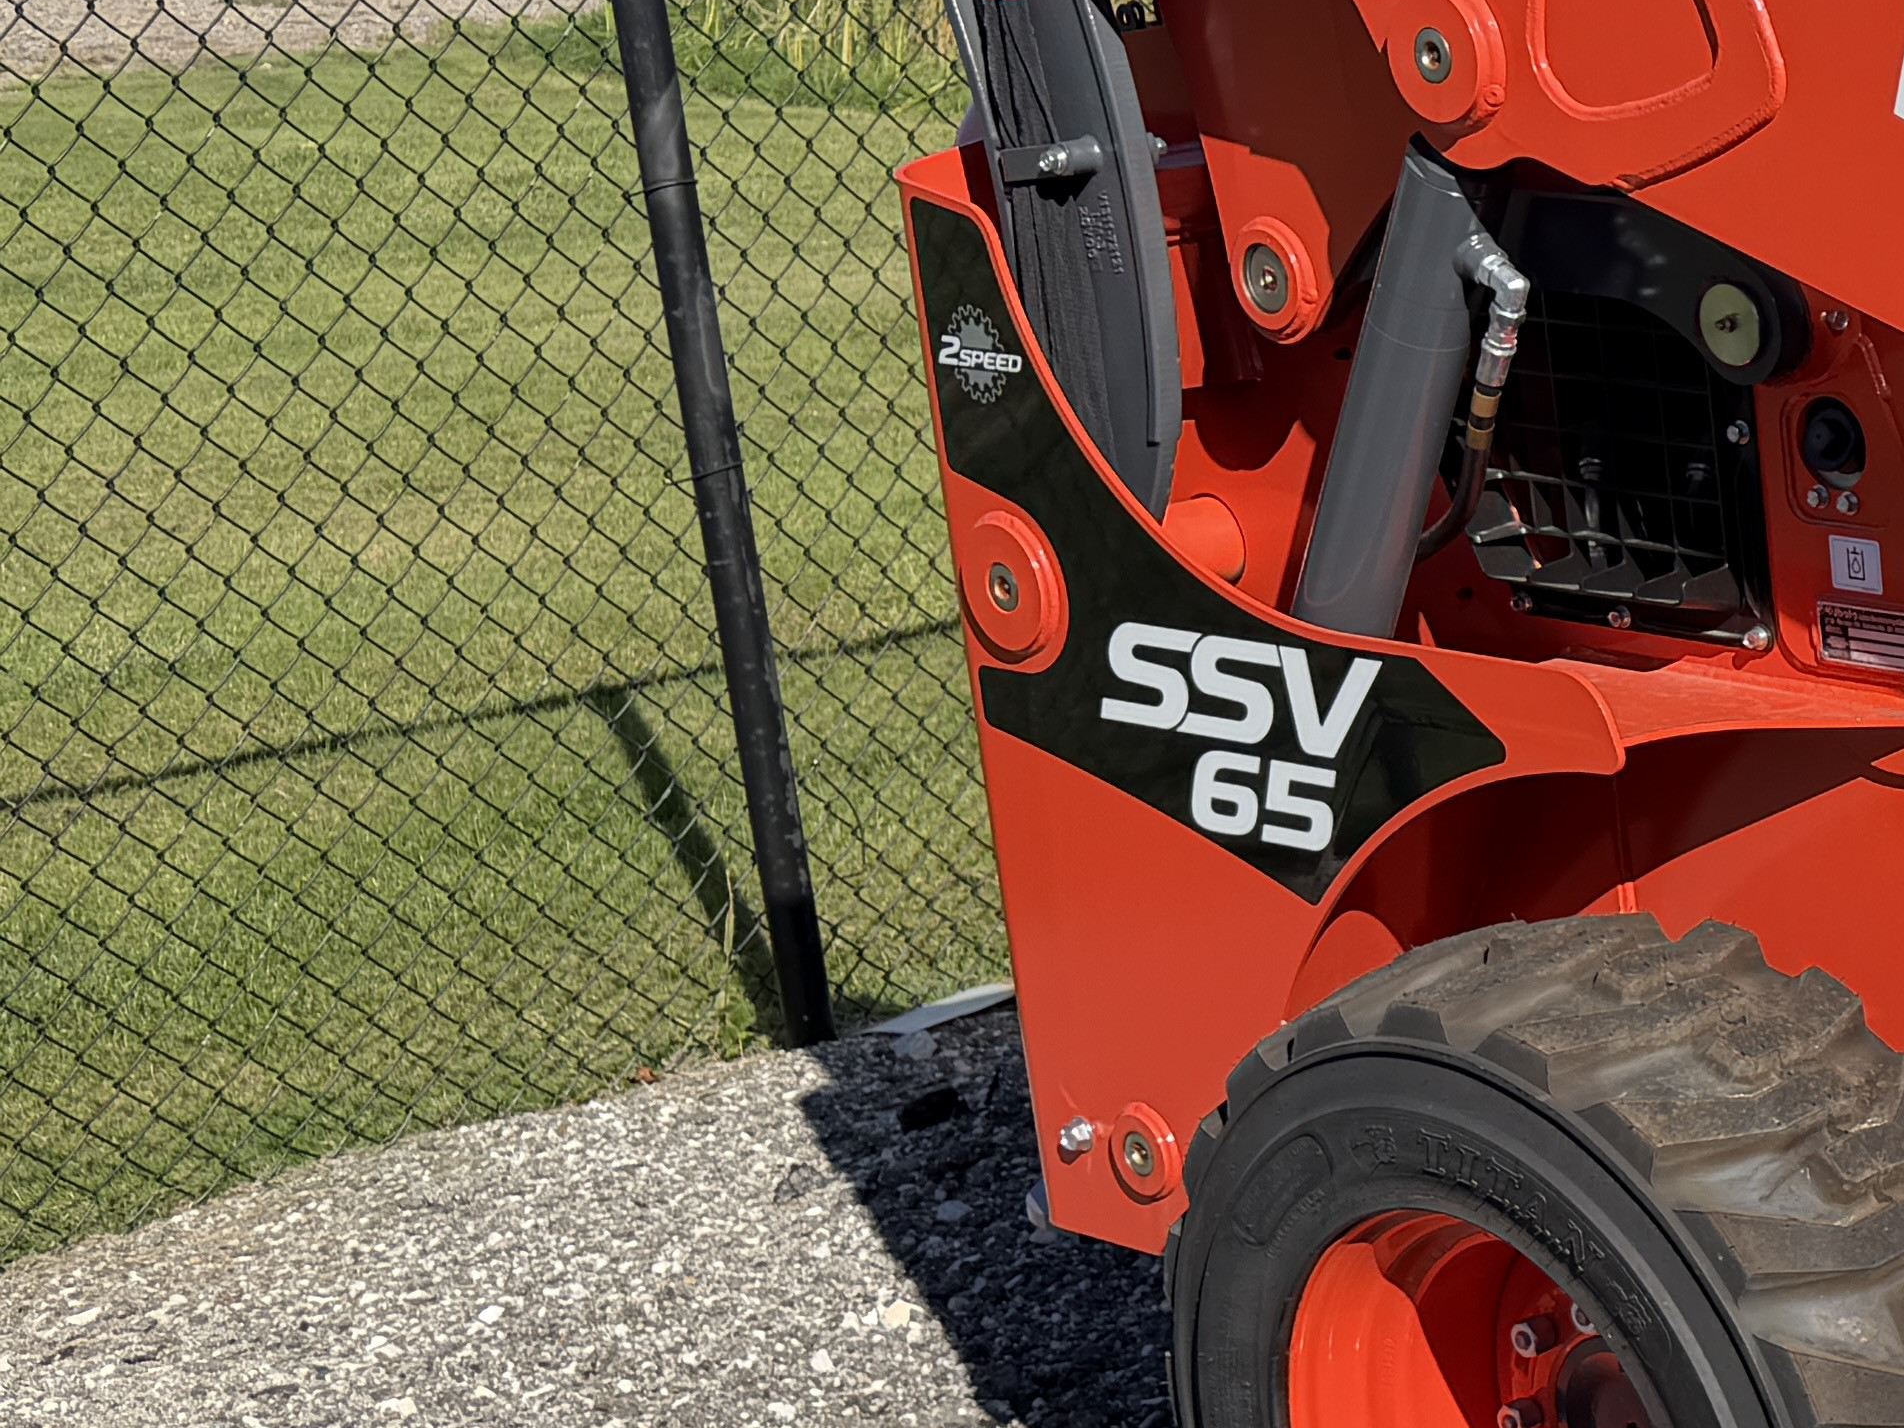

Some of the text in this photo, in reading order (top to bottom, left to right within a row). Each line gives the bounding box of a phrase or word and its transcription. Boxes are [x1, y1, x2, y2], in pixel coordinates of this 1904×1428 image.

[1100, 621, 1384, 759] SSV
[1191, 749, 1337, 853] 65
[1417, 1127, 1606, 1273] TITAN
